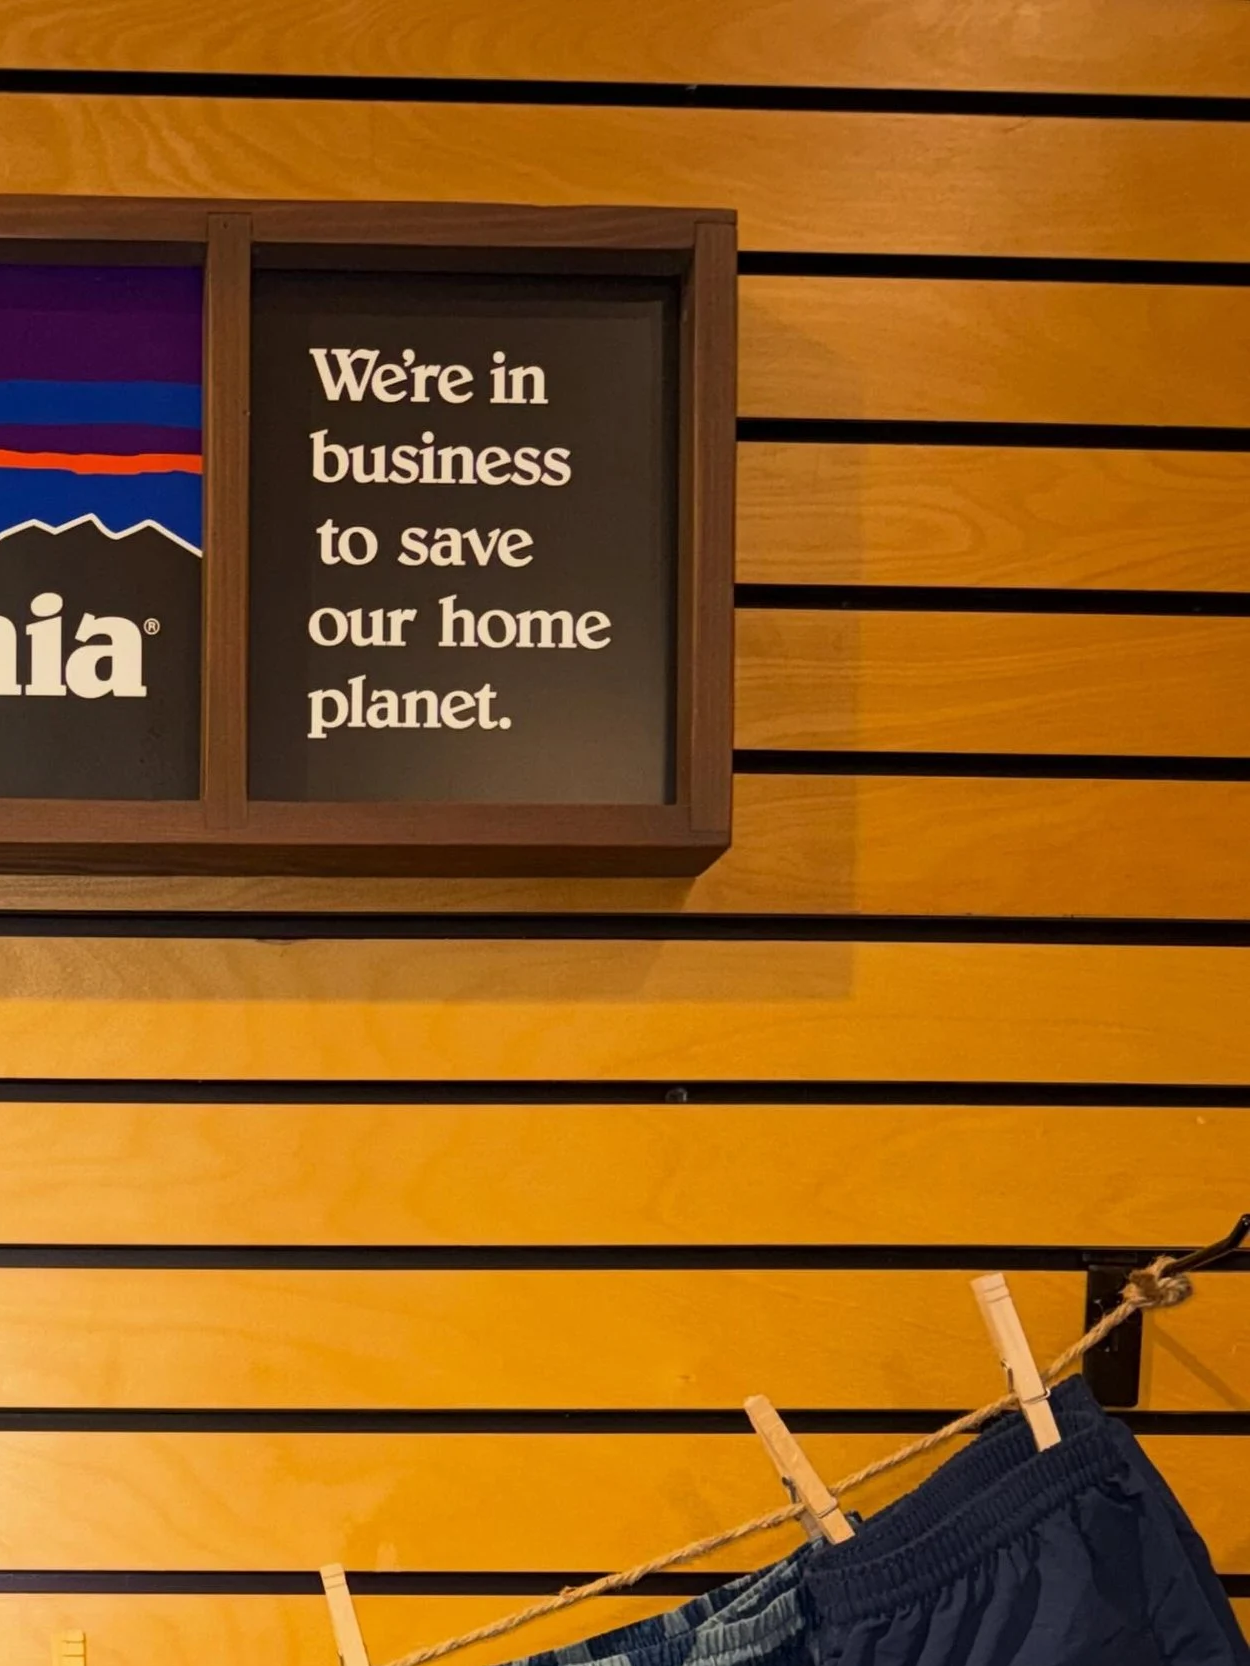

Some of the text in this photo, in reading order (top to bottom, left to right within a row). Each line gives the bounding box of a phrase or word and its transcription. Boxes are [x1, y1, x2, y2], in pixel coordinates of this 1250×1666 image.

[489, 351, 549, 404] in
[309, 429, 572, 486] business
[316, 518, 534, 568] to save
[308, 594, 612, 650] our home
[307, 674, 512, 739] planet.
